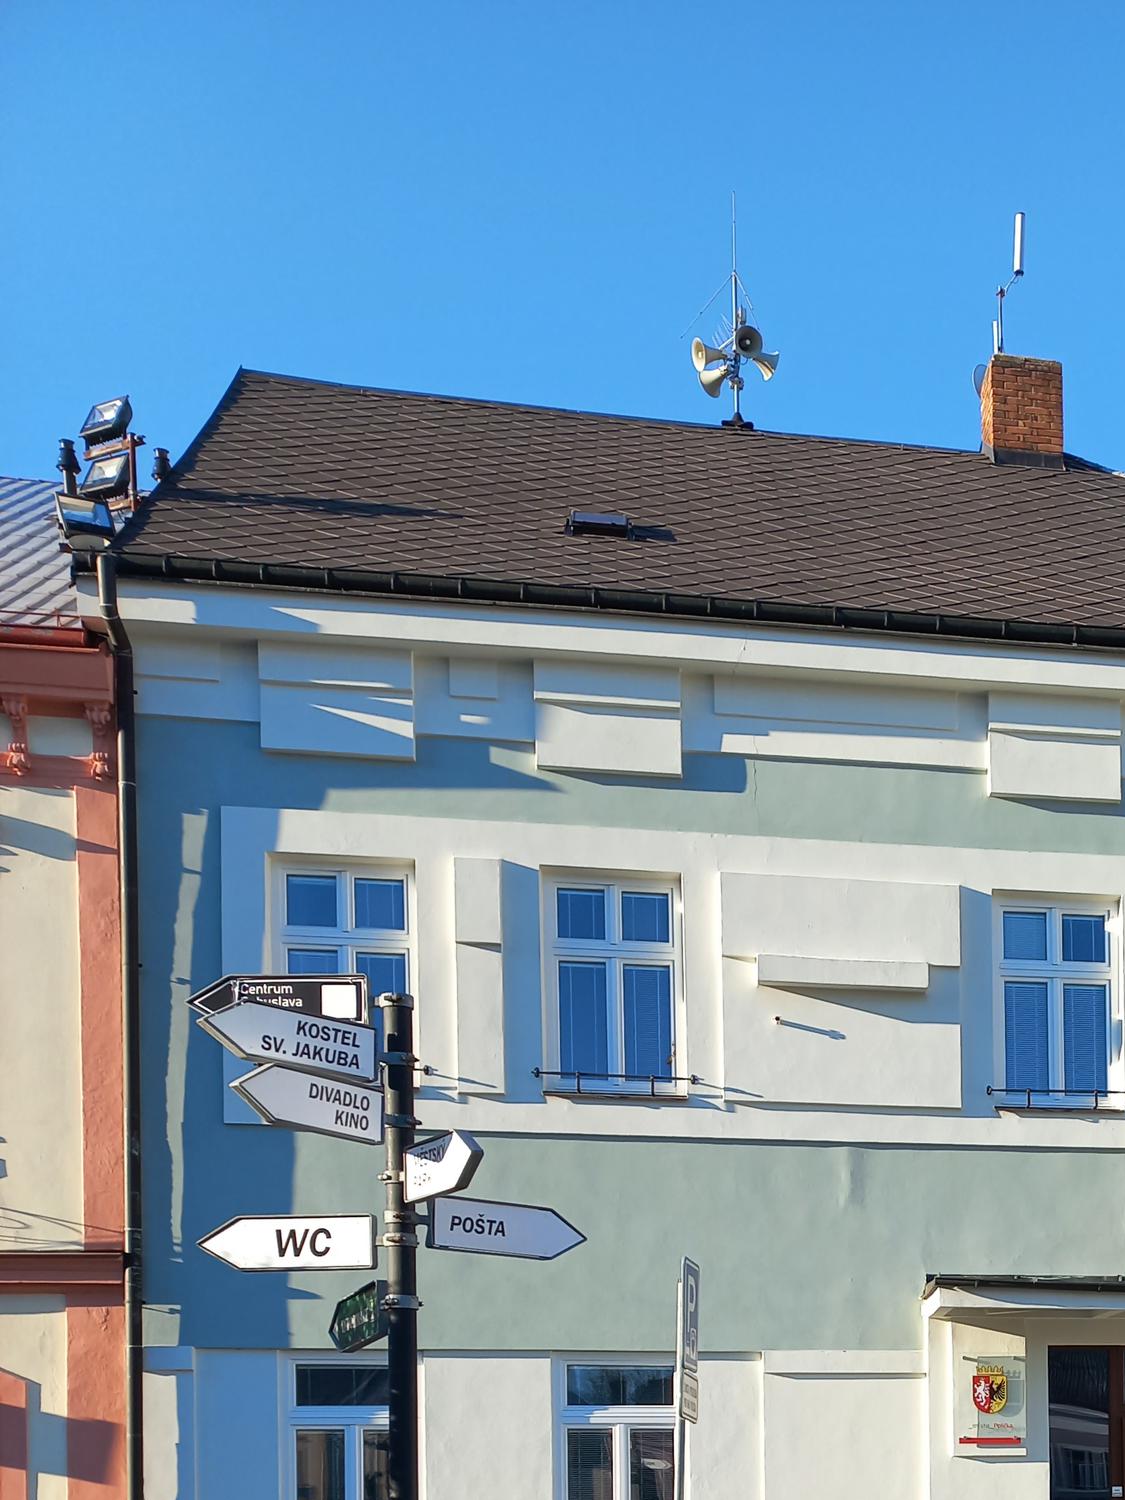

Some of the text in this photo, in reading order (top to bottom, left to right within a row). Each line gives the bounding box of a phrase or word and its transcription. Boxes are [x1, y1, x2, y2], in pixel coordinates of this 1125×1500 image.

[241, 983, 293, 995] Centrum
[296, 1020, 361, 1049] KOSTEL
[261, 1035, 360, 1070] SV. JAKUBA
[308, 1082, 370, 1112] DIVADLO
[334, 1109, 369, 1131] KINO
[449, 1213, 506, 1238] POŠTA
[275, 1228, 332, 1258] WC
